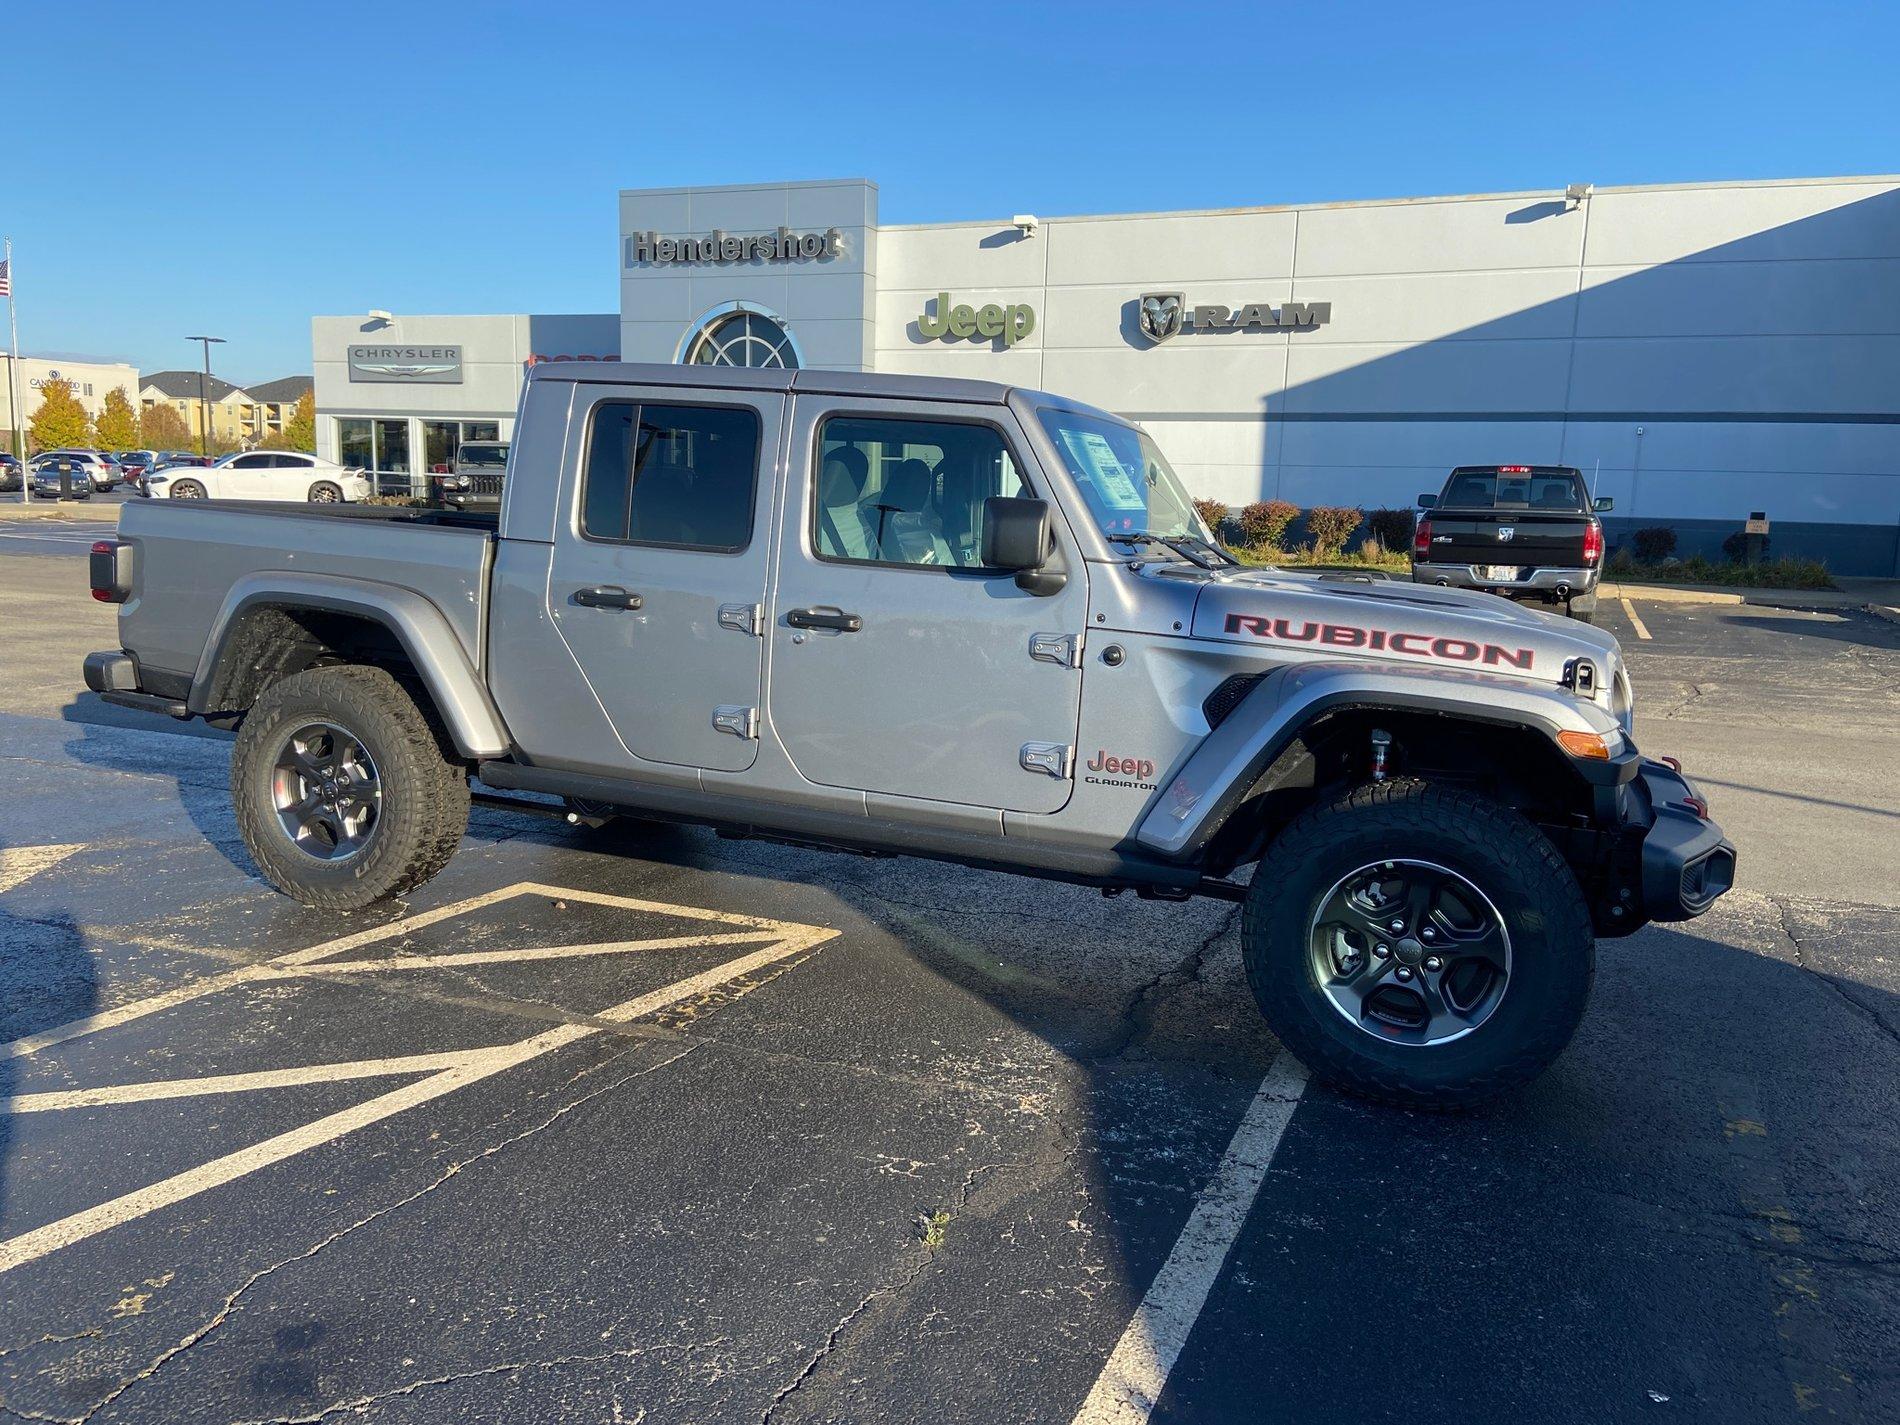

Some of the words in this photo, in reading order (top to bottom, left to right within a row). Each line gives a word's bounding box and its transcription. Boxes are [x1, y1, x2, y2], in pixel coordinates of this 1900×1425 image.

[632, 226, 841, 261] Hendershot
[918, 292, 1035, 345] Jeep
[1193, 302, 1332, 327] RAM
[354, 349, 457, 358] CHRYSLER
[1223, 613, 1535, 671] RUBICON
[1087, 750, 1154, 780] Jeep
[1085, 776, 1158, 791] GLADIATOR
